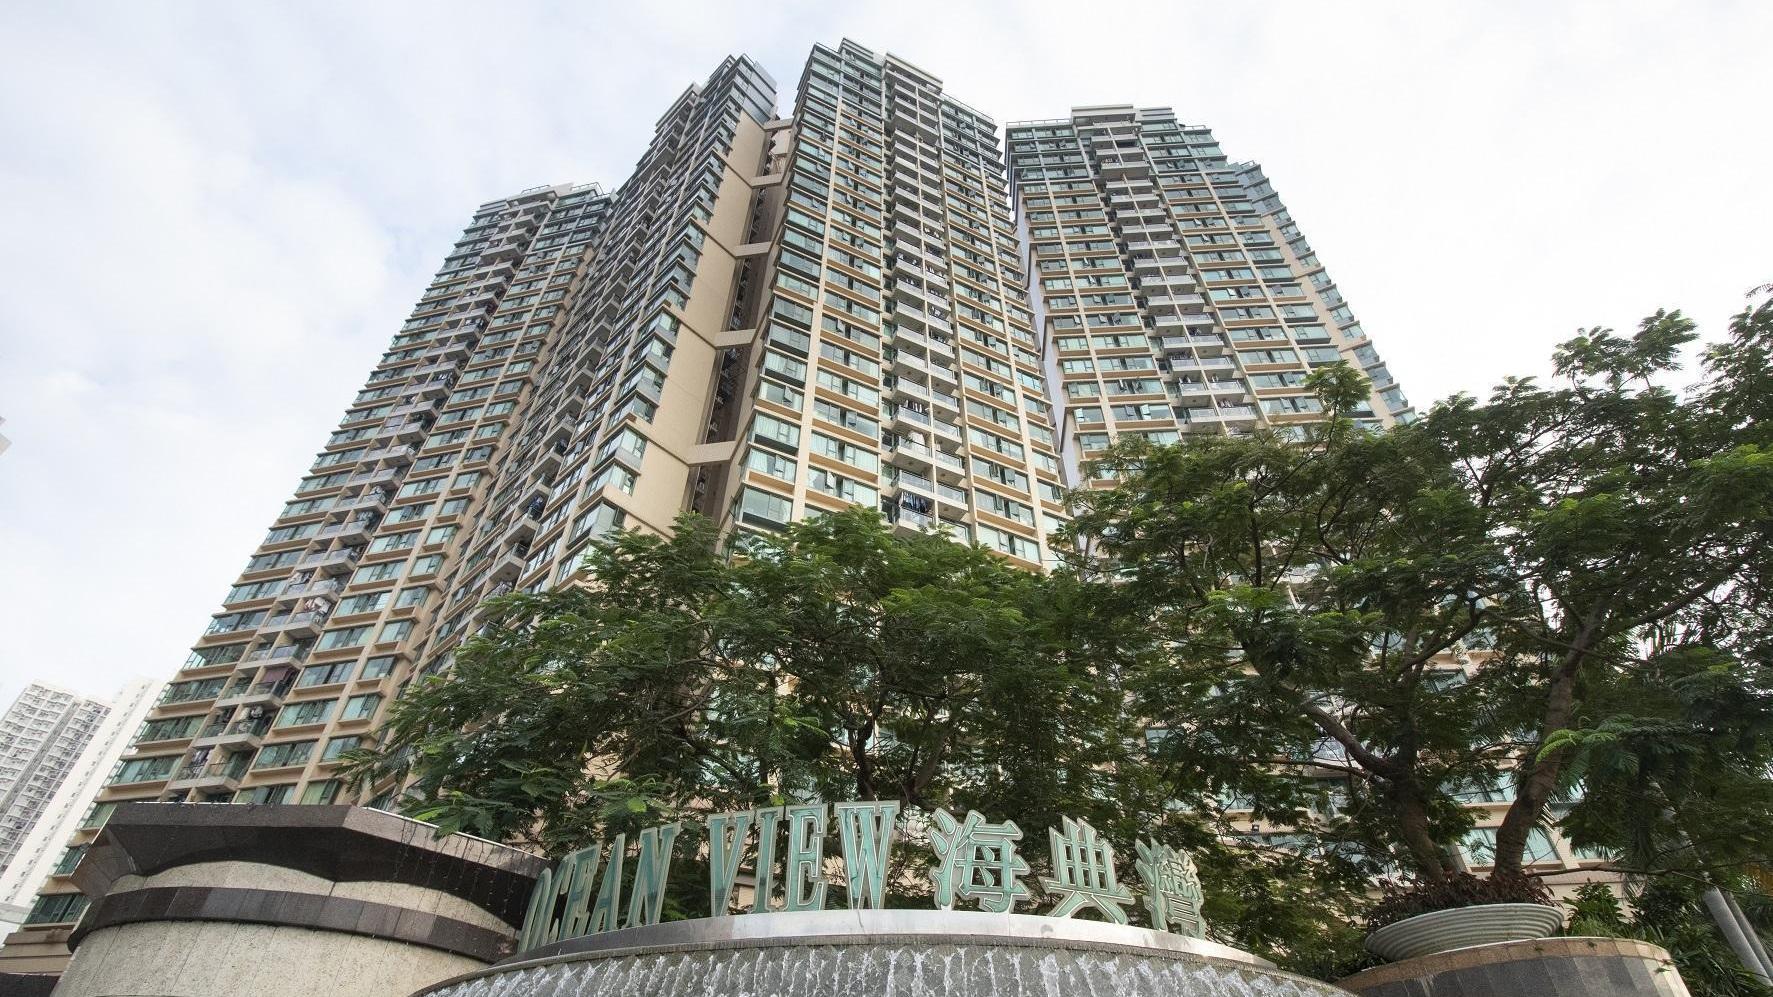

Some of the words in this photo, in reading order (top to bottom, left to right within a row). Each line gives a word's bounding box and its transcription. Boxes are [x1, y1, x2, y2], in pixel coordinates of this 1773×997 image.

[517, 821, 682, 952] OCEAN
[707, 800, 901, 916] VIEW
[928, 808, 1206, 940] 海典灣
